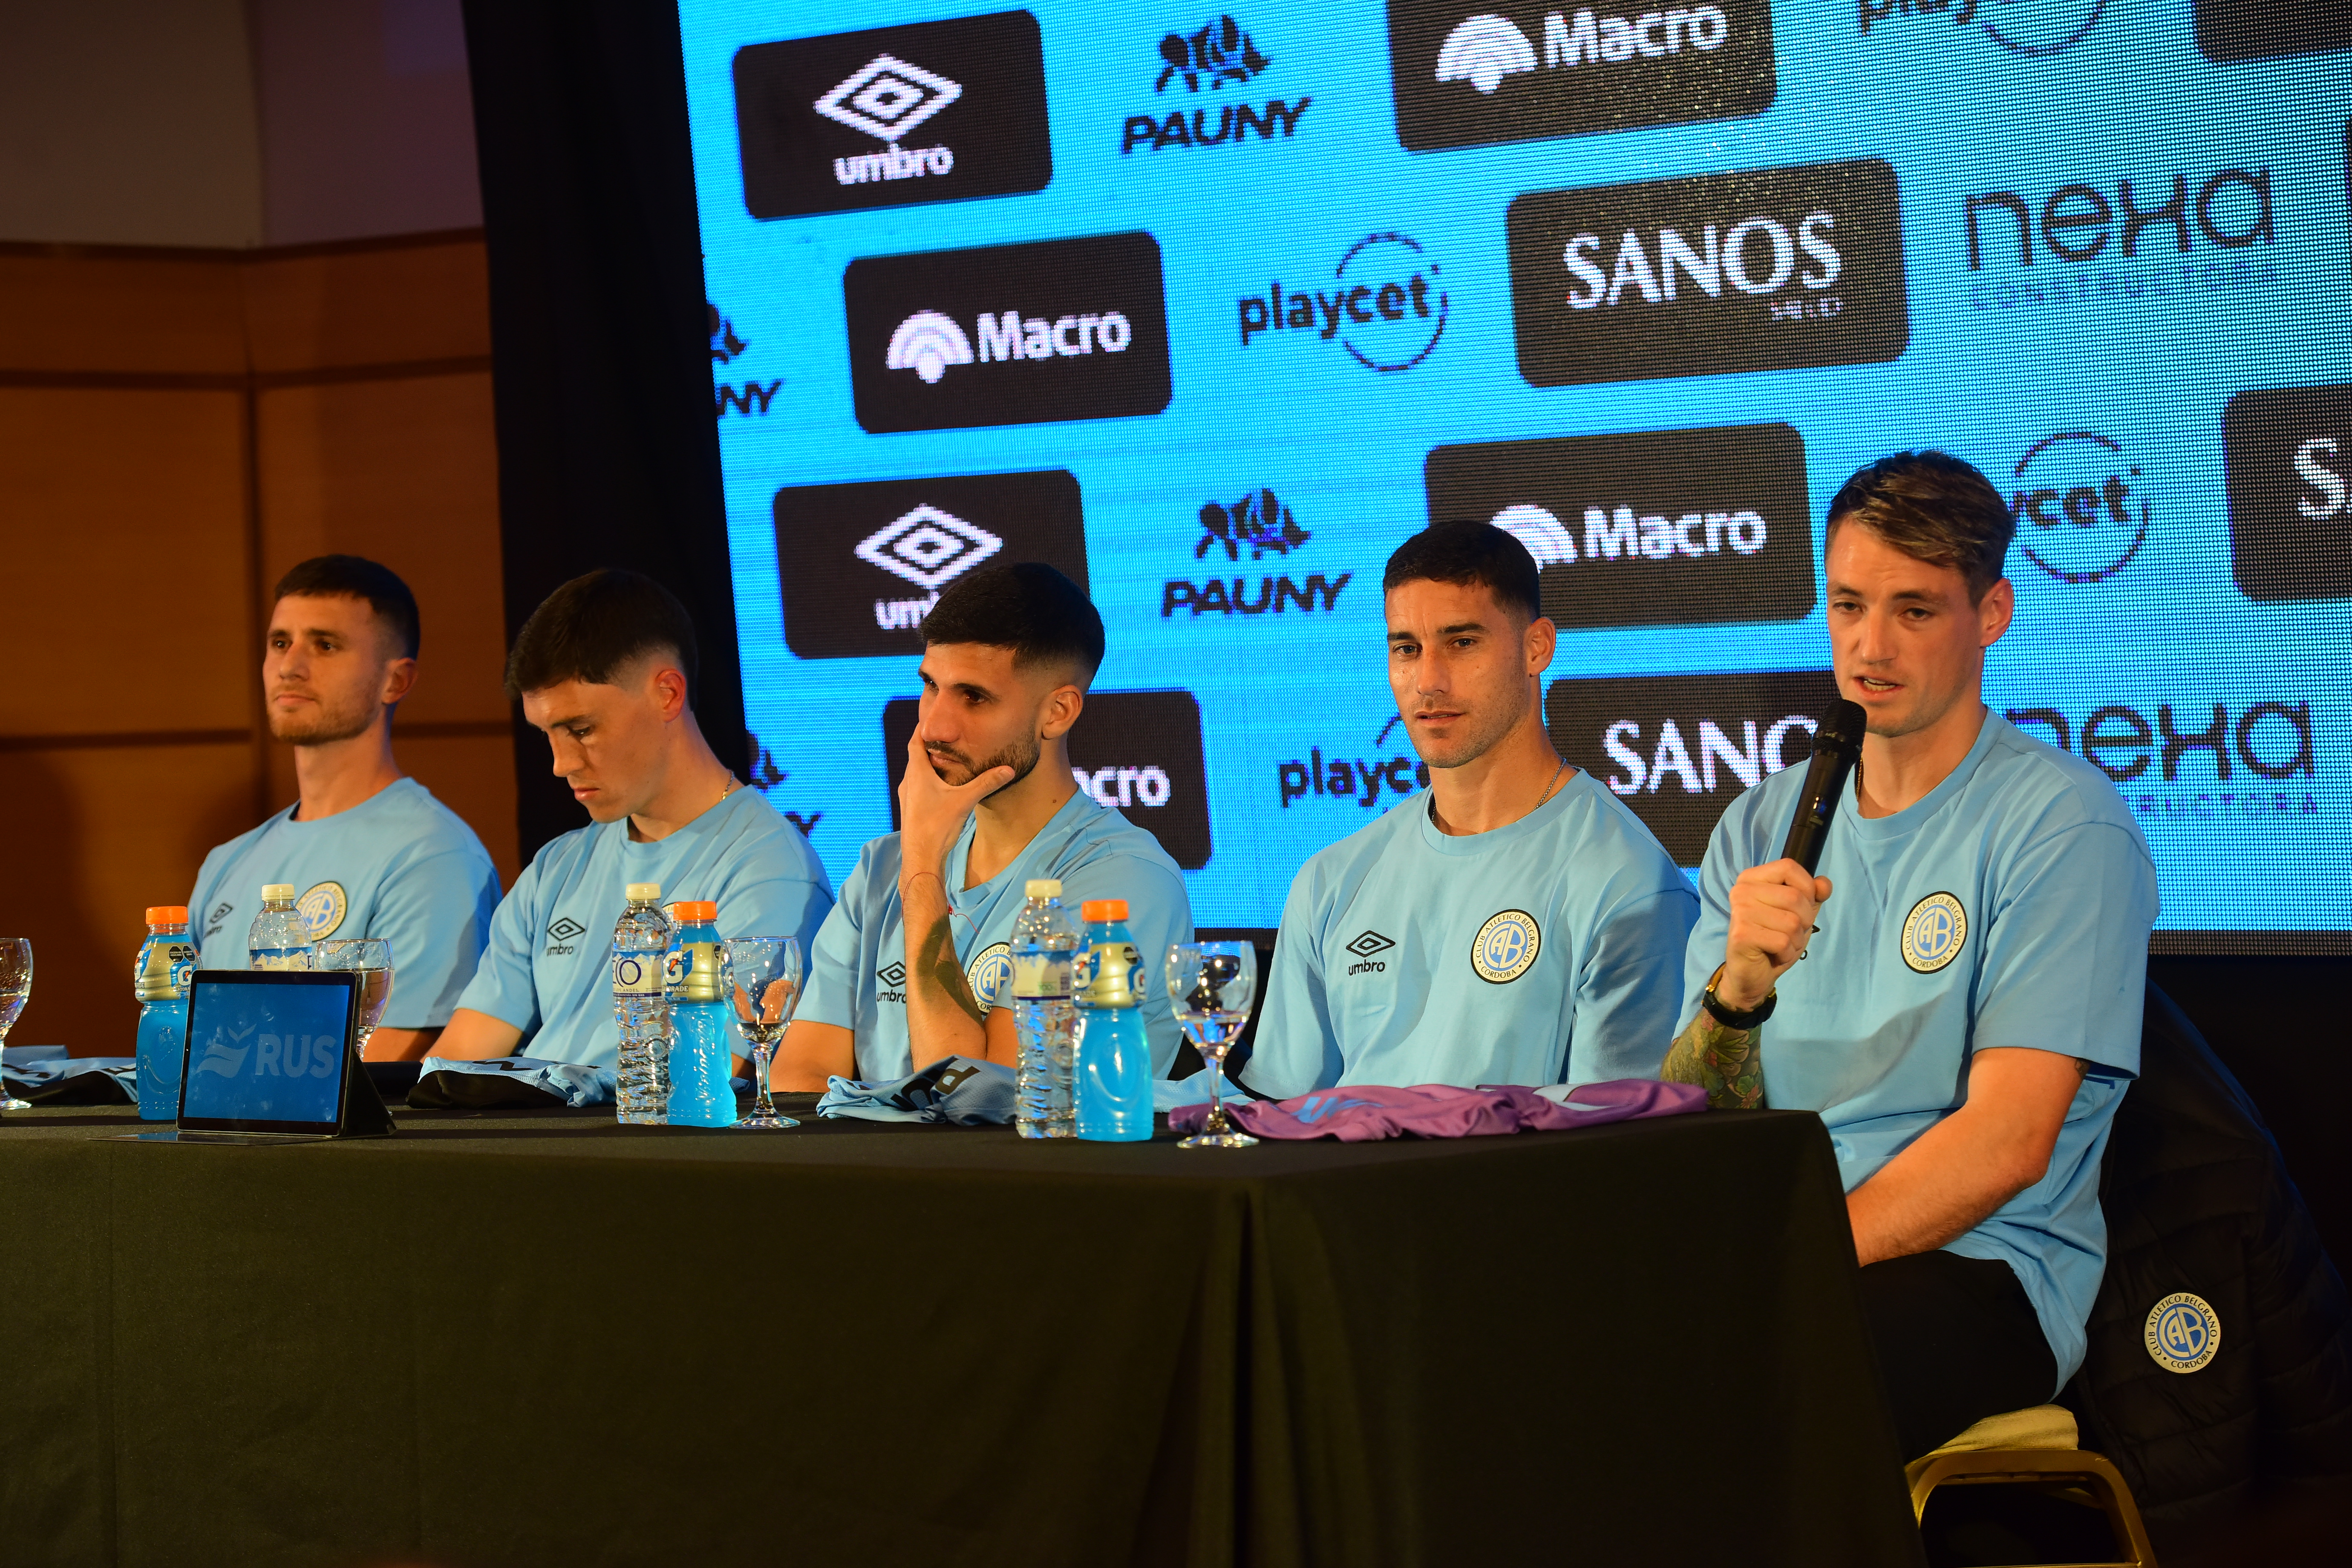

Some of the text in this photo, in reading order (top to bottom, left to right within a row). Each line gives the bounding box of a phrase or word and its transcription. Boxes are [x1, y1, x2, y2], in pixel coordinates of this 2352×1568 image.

[1542, 5, 1727, 68] Macro
[1121, 96, 1312, 155] PAUNY
[833, 140, 954, 186] umbro
[1562, 210, 1842, 309] SANOS
[1239, 272, 1430, 347] playcet
[1970, 262, 2280, 311] CONSTRUCTORA
[977, 311, 1132, 362] Macro
[1583, 504, 1767, 561] Macro
[1161, 570, 1354, 619] PAUNY
[1279, 747, 1431, 808] playc
[1604, 715, 1819, 795] SANO
[1072, 766, 1171, 807] cro
[2126, 792, 2318, 820] RUCTORA
[1476, 914, 1535, 962] CLUB ATLETICO BELGRANO
[1912, 896, 1944, 922] ATLETICO
[1945, 899, 1962, 946] BELGRANO
[663, 951, 683, 984] G
[974, 946, 1005, 969] ATLETICO
[1072, 953, 1091, 988] G
[1348, 959, 1385, 976] umbro
[1481, 966, 1517, 978] CORDOBA
[1912, 956, 1948, 968] CORDOBA
[255, 1034, 337, 1078] RUS
[2148, 1295, 2217, 1356] CLUB ATLETICO BELGRANO
[2159, 1307, 2206, 1358] CAB
[2171, 1350, 2212, 1369] CORDOBA
